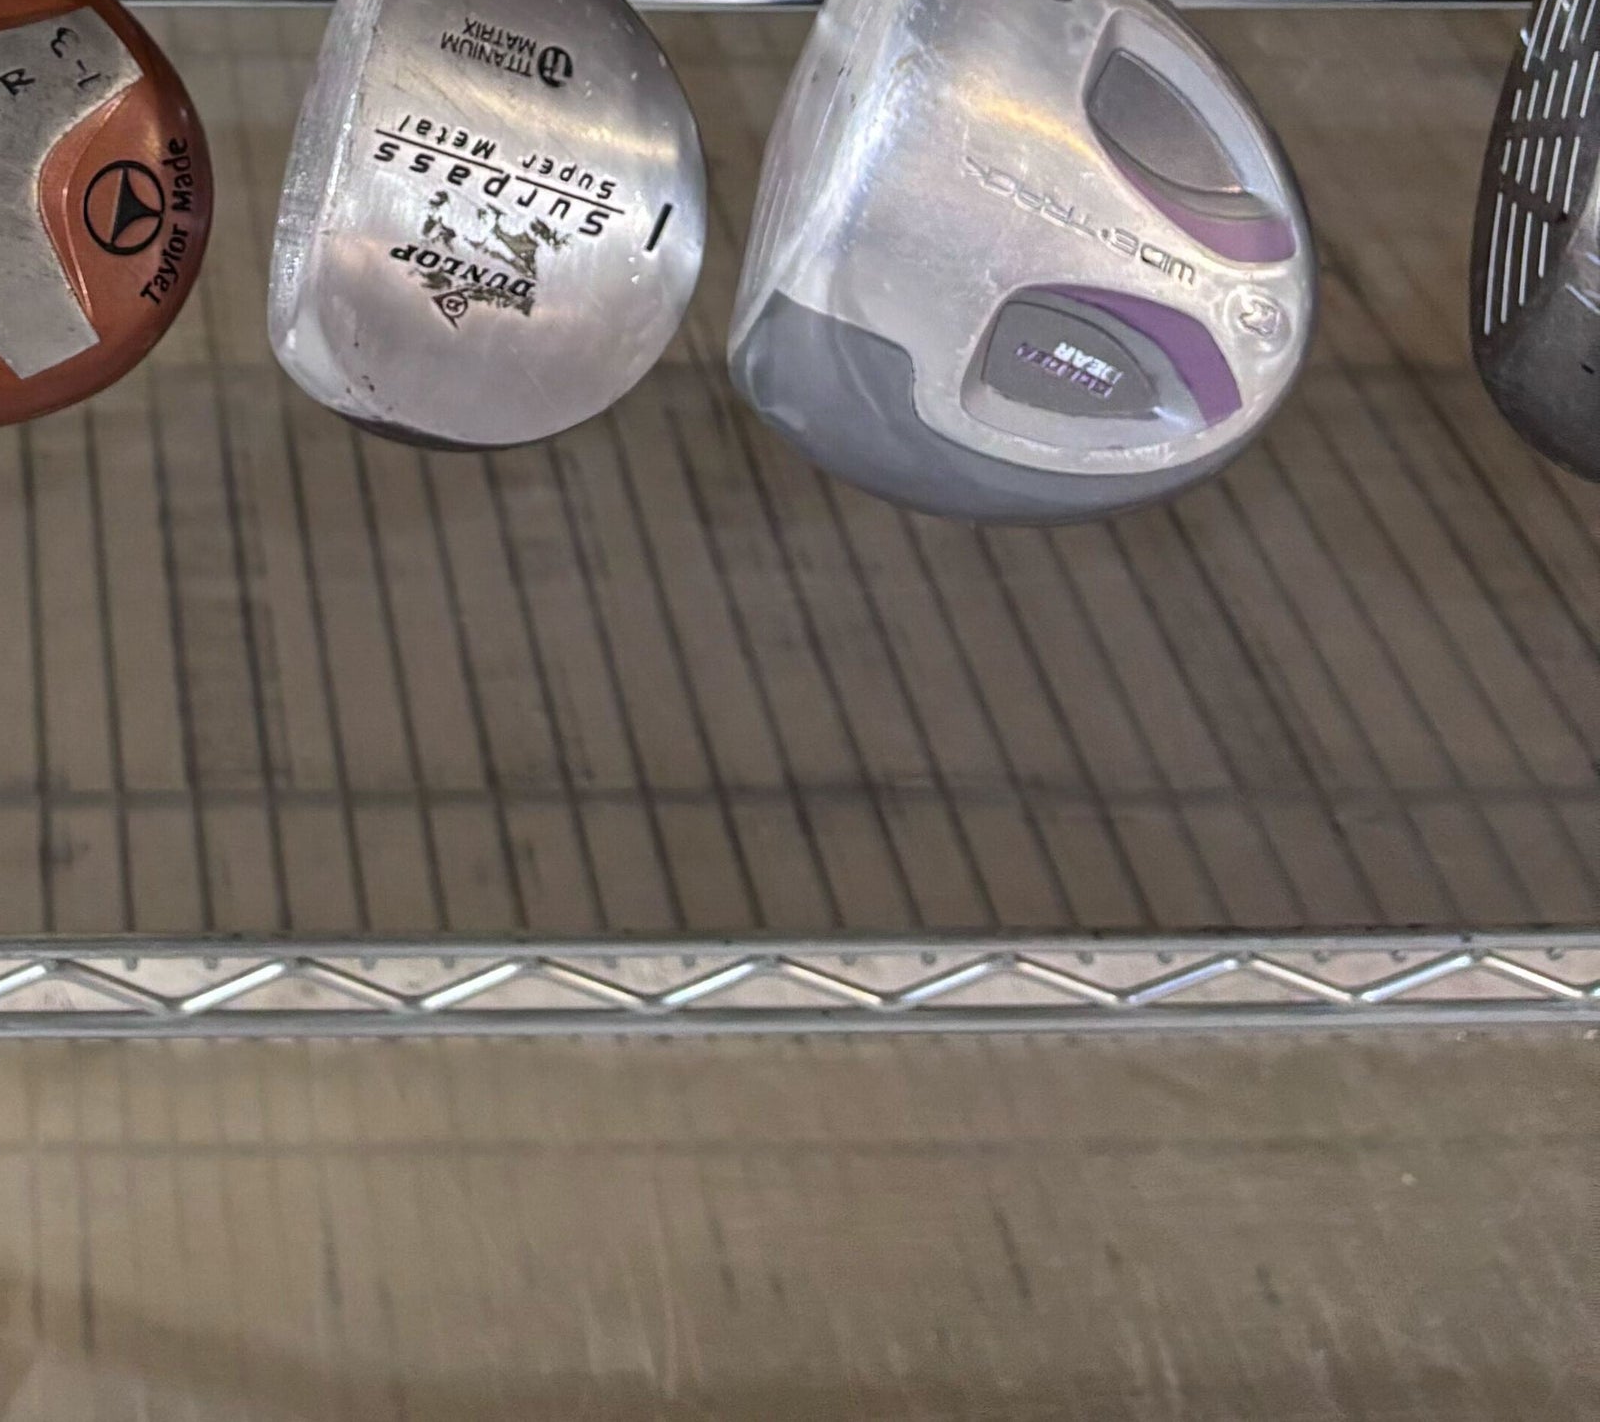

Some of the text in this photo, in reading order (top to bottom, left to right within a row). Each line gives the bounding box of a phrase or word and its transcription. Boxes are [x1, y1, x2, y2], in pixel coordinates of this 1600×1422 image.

[440, 32, 533, 77] TITANIUM
[463, 18, 536, 53] MATRIX
[399, 115, 496, 160] Metal
[373, 142, 610, 236] Surpass
[141, 137, 195, 307] Taylor Made
[390, 244, 535, 297] DUNLOP
